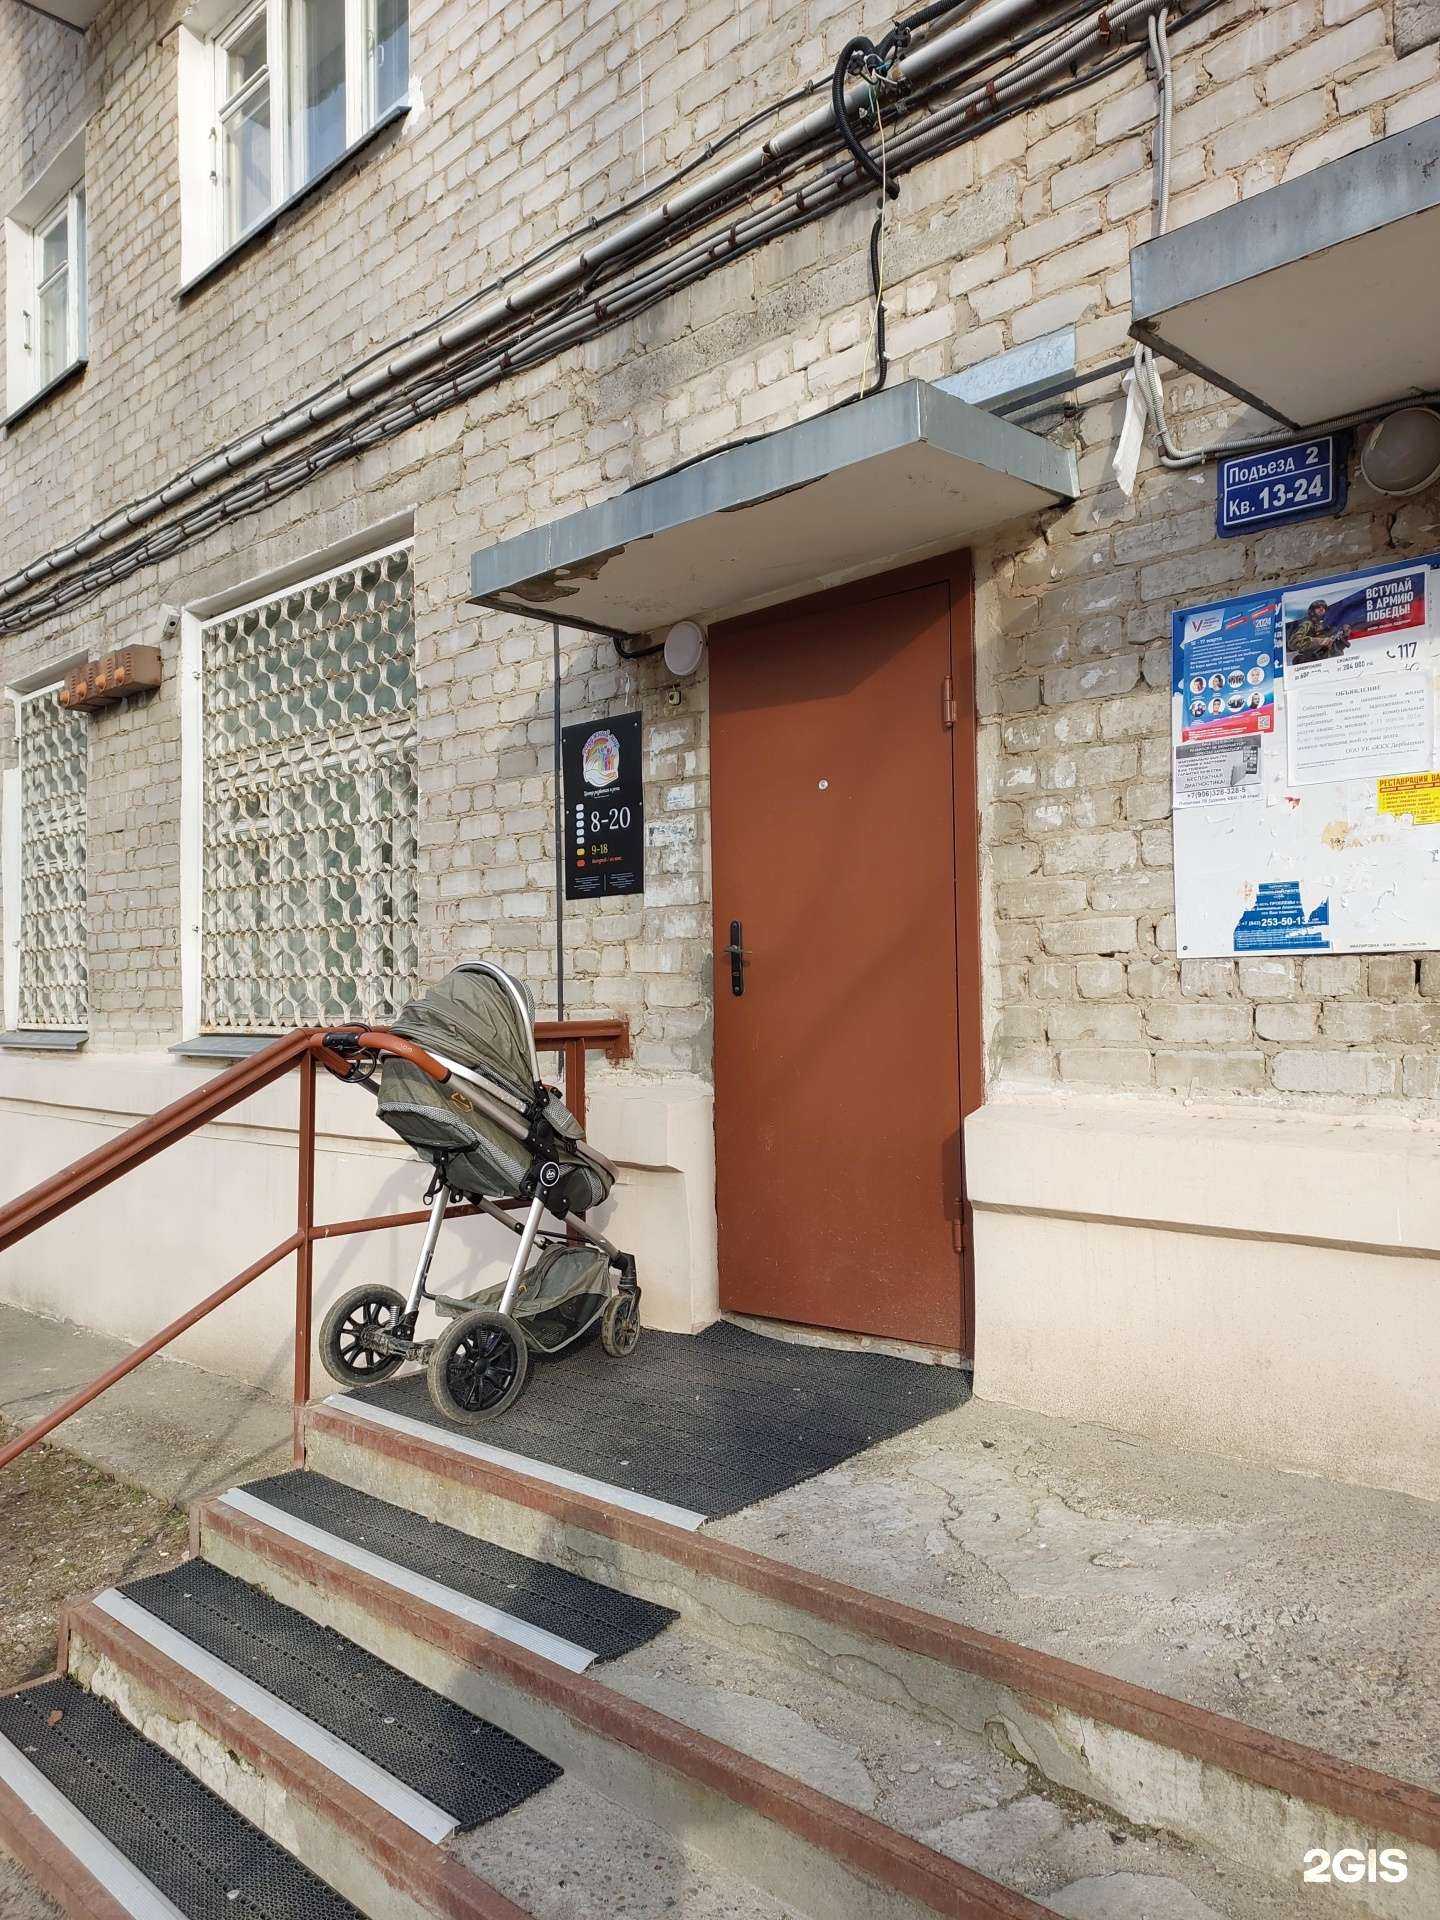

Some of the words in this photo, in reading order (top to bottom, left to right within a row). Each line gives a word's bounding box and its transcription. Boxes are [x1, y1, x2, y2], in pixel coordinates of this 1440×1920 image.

[1229, 456, 1295, 484] Подъезд
[1305, 446, 1319, 464] 2
[1229, 498, 1255, 517] Кв.
[1259, 474, 1323, 509] 13-24
[1365, 578, 1412, 599] ВСТУПАЙ
[1366, 600, 1373, 611] В
[1376, 591, 1414, 609] АРМИЮ
[1367, 603, 1411, 622] ПОБЕДЫ!
[1398, 641, 1418, 658] 117
[590, 806, 631, 832] 8-20
[591, 843, 608, 855] 9-18
